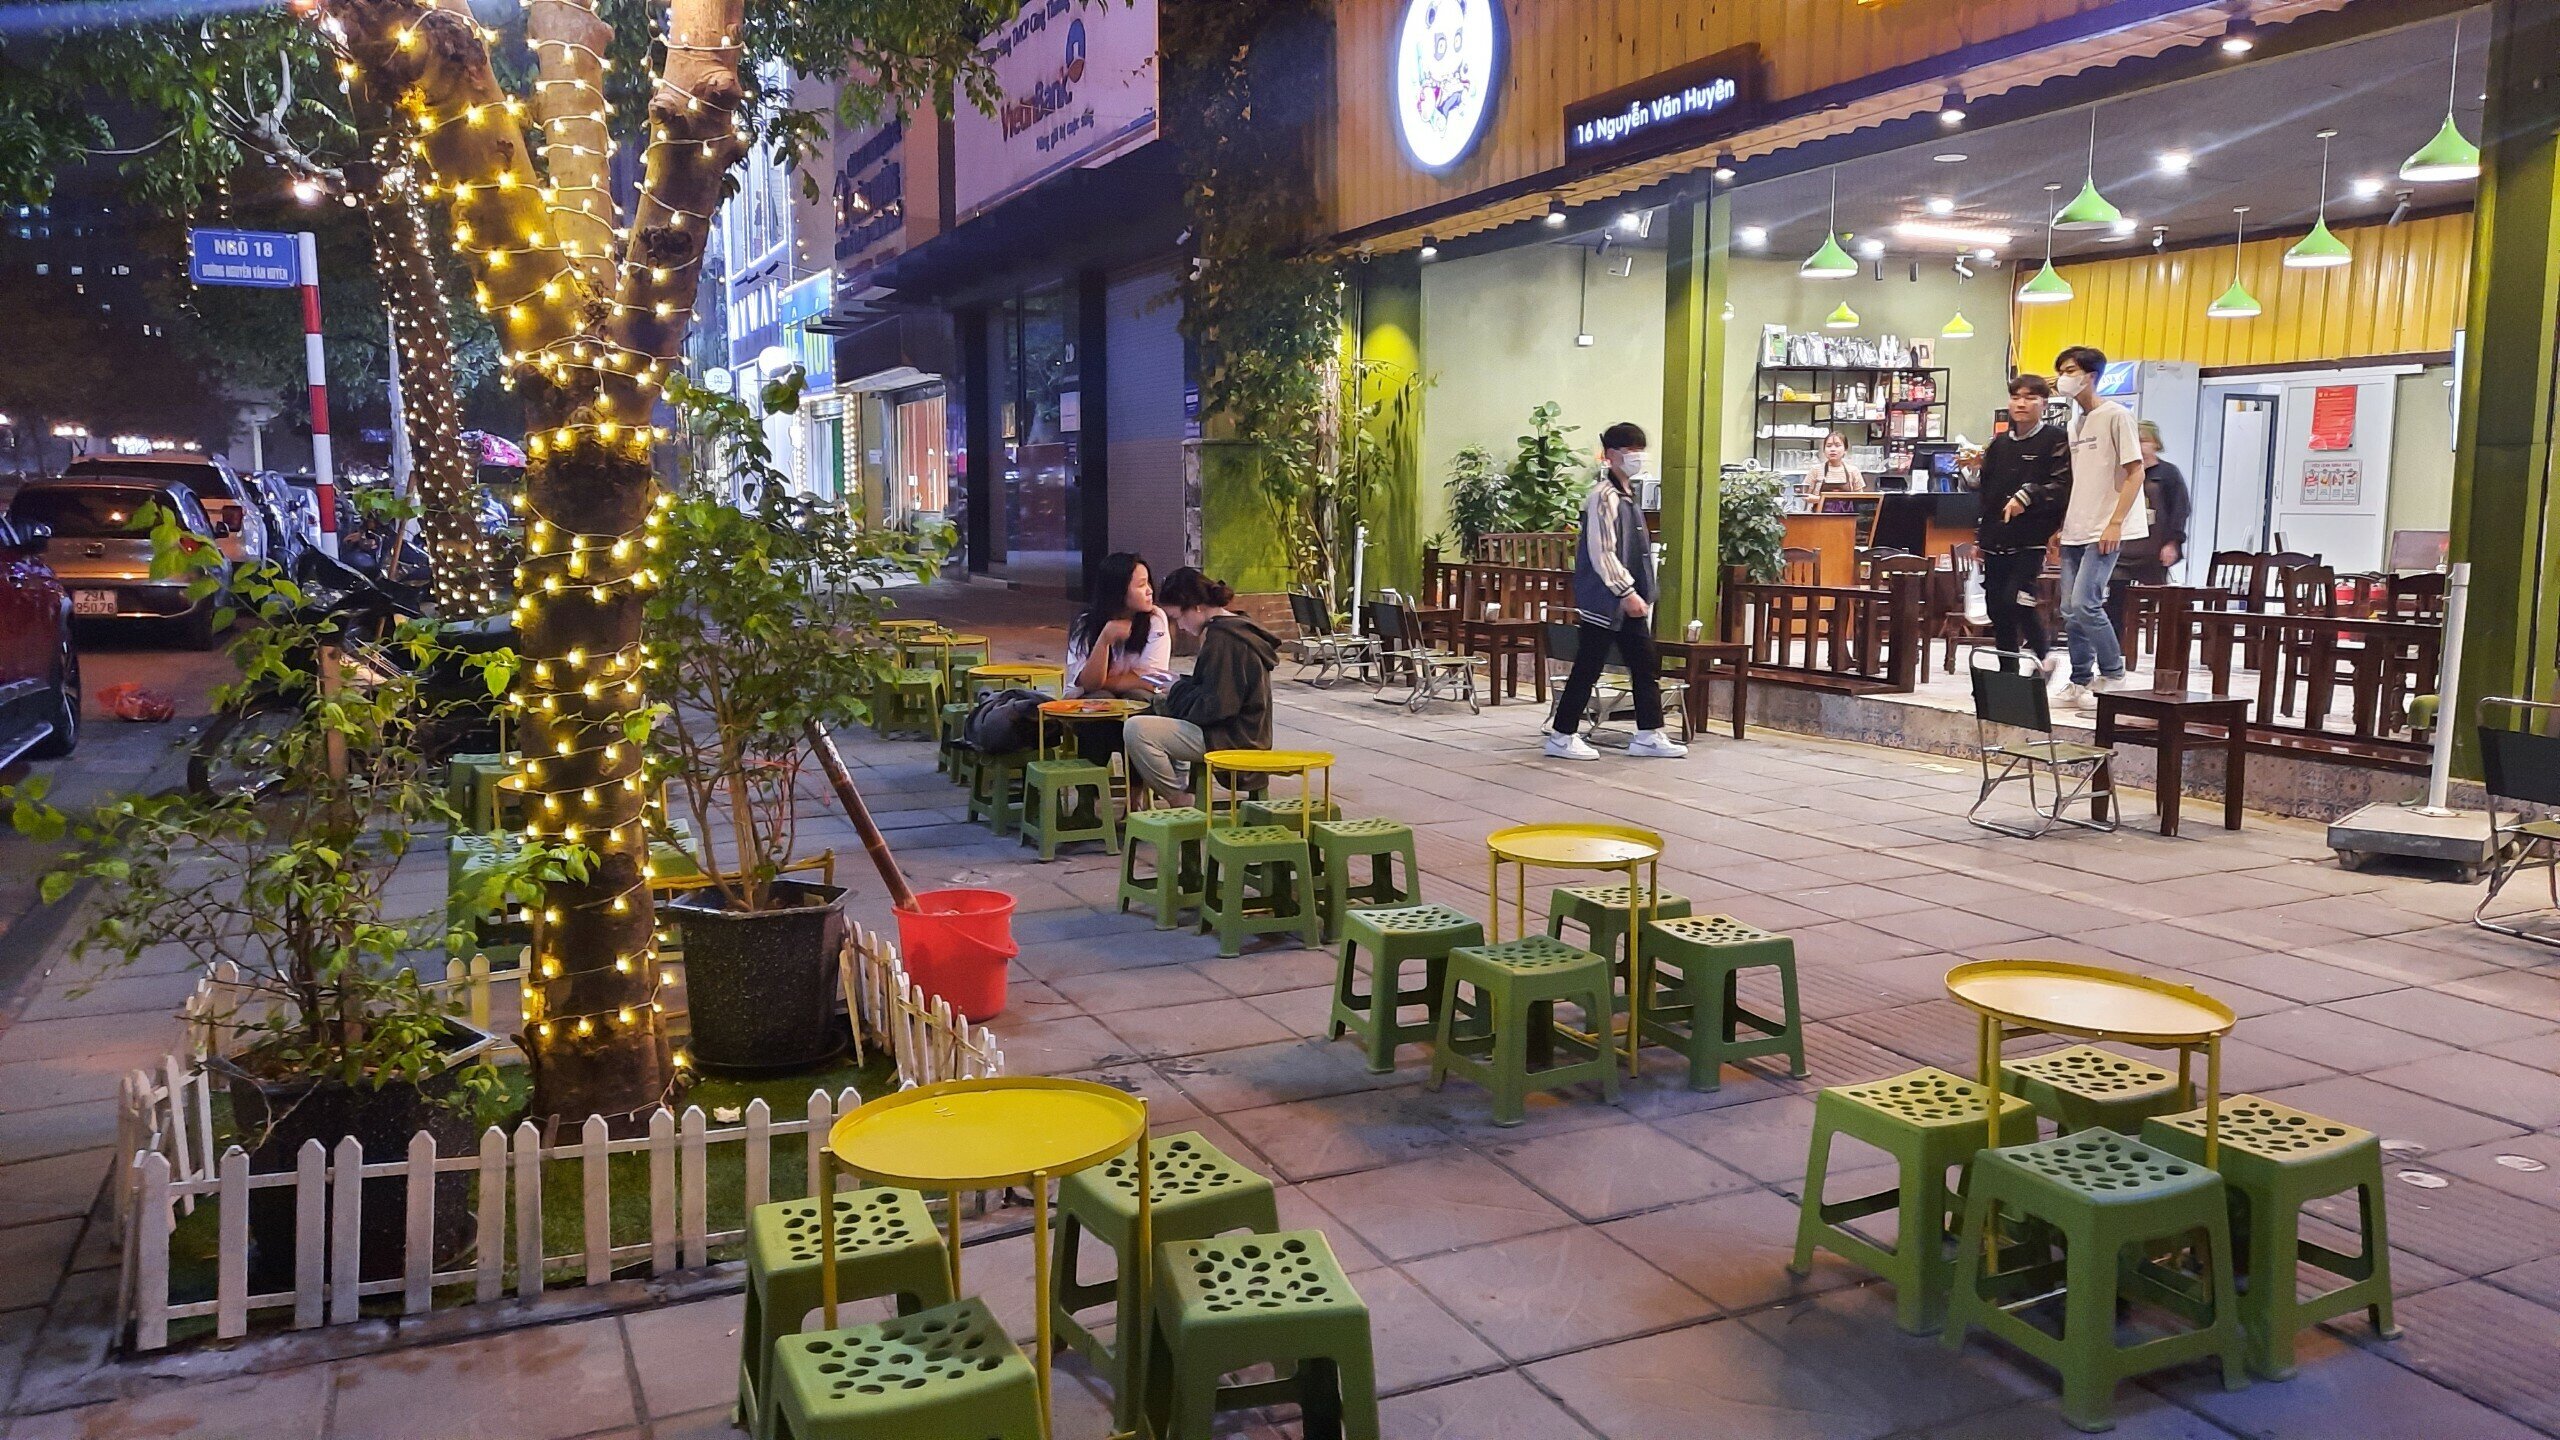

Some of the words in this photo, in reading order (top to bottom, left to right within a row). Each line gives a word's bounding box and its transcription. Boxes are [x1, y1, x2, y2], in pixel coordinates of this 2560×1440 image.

[1577, 121, 1594, 144] 16
[1596, 101, 1649, 140] Nguyễn
[1651, 95, 1681, 121] Văn
[1684, 78, 1735, 110] Huyên
[214, 237, 248, 256] NGÕ
[254, 241, 274, 257] 18
